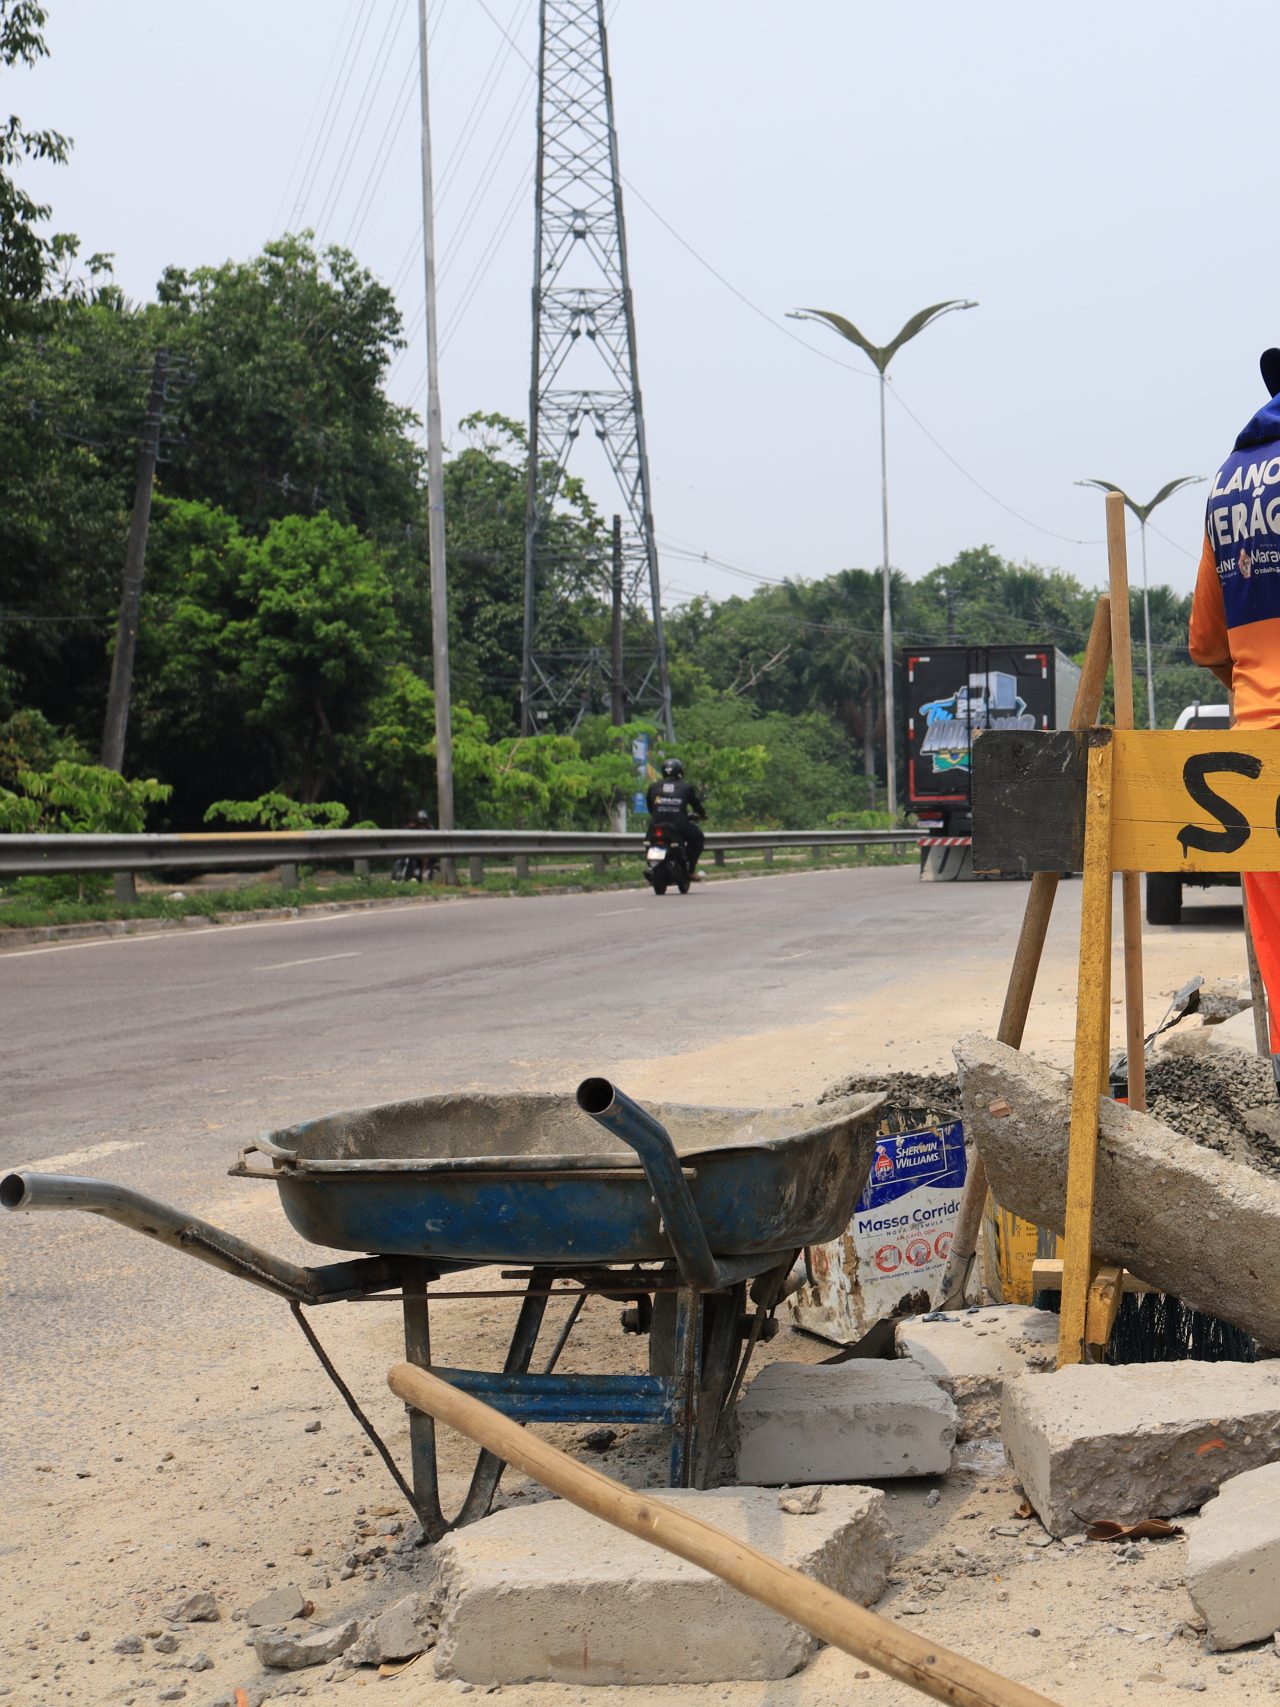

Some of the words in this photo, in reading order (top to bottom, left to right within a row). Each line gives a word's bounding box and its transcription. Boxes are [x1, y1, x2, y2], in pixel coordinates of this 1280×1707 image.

[896, 1153, 938, 1169] WILLIAMS
[859, 1215, 909, 1233] Massa
[887, 1228, 907, 1236] NOVA
